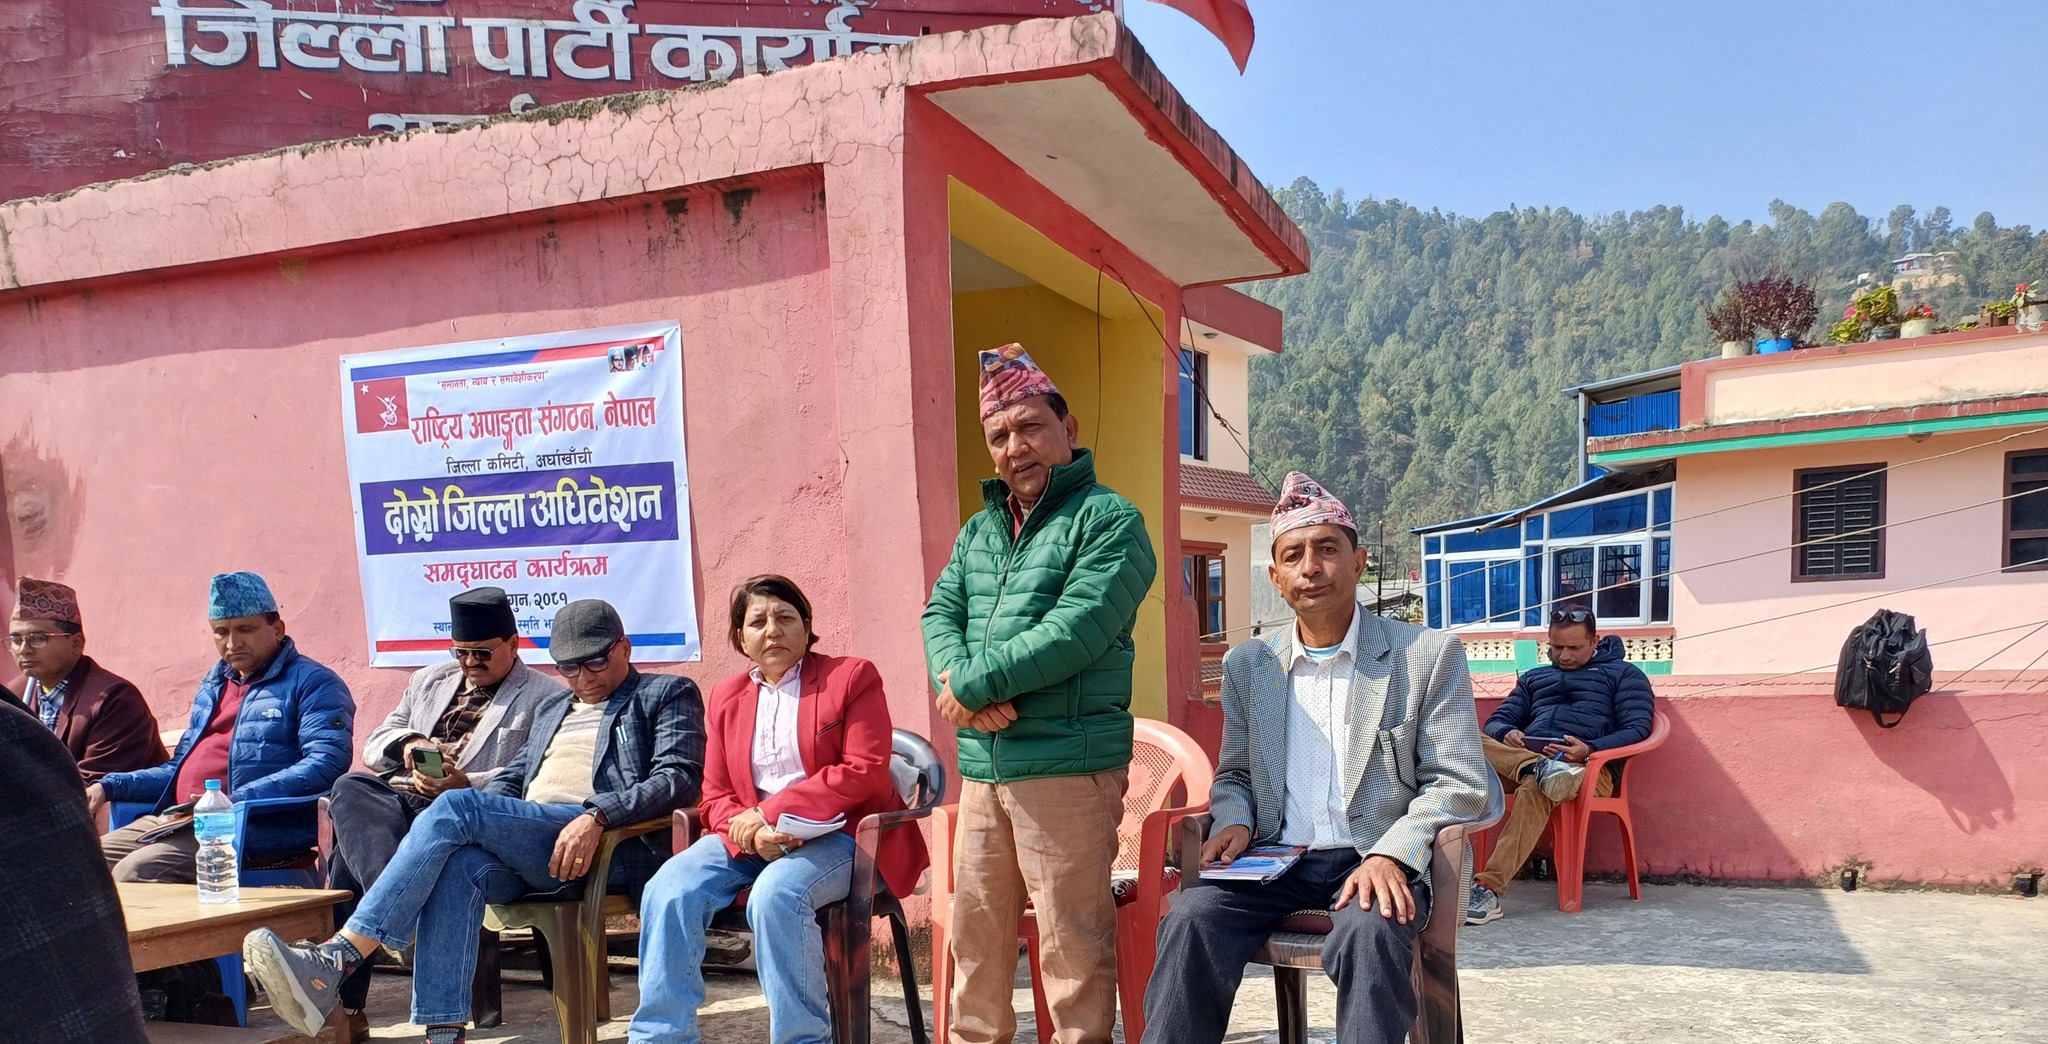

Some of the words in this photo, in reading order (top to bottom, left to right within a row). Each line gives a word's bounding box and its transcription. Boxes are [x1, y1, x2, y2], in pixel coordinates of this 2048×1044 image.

[151, 0, 456, 74] जिल्ला
[461, 0, 640, 81] पार्टी
[645, 5, 916, 82] कार्या
[604, 391, 656, 427] नेपाल
[446, 456, 482, 474] जिल्ला
[487, 451, 529, 471] कमिटी,
[442, 484, 526, 535] जिल्ला
[529, 474, 663, 533] अधिवेशन
[525, 550, 609, 578] कार्यक्रम
